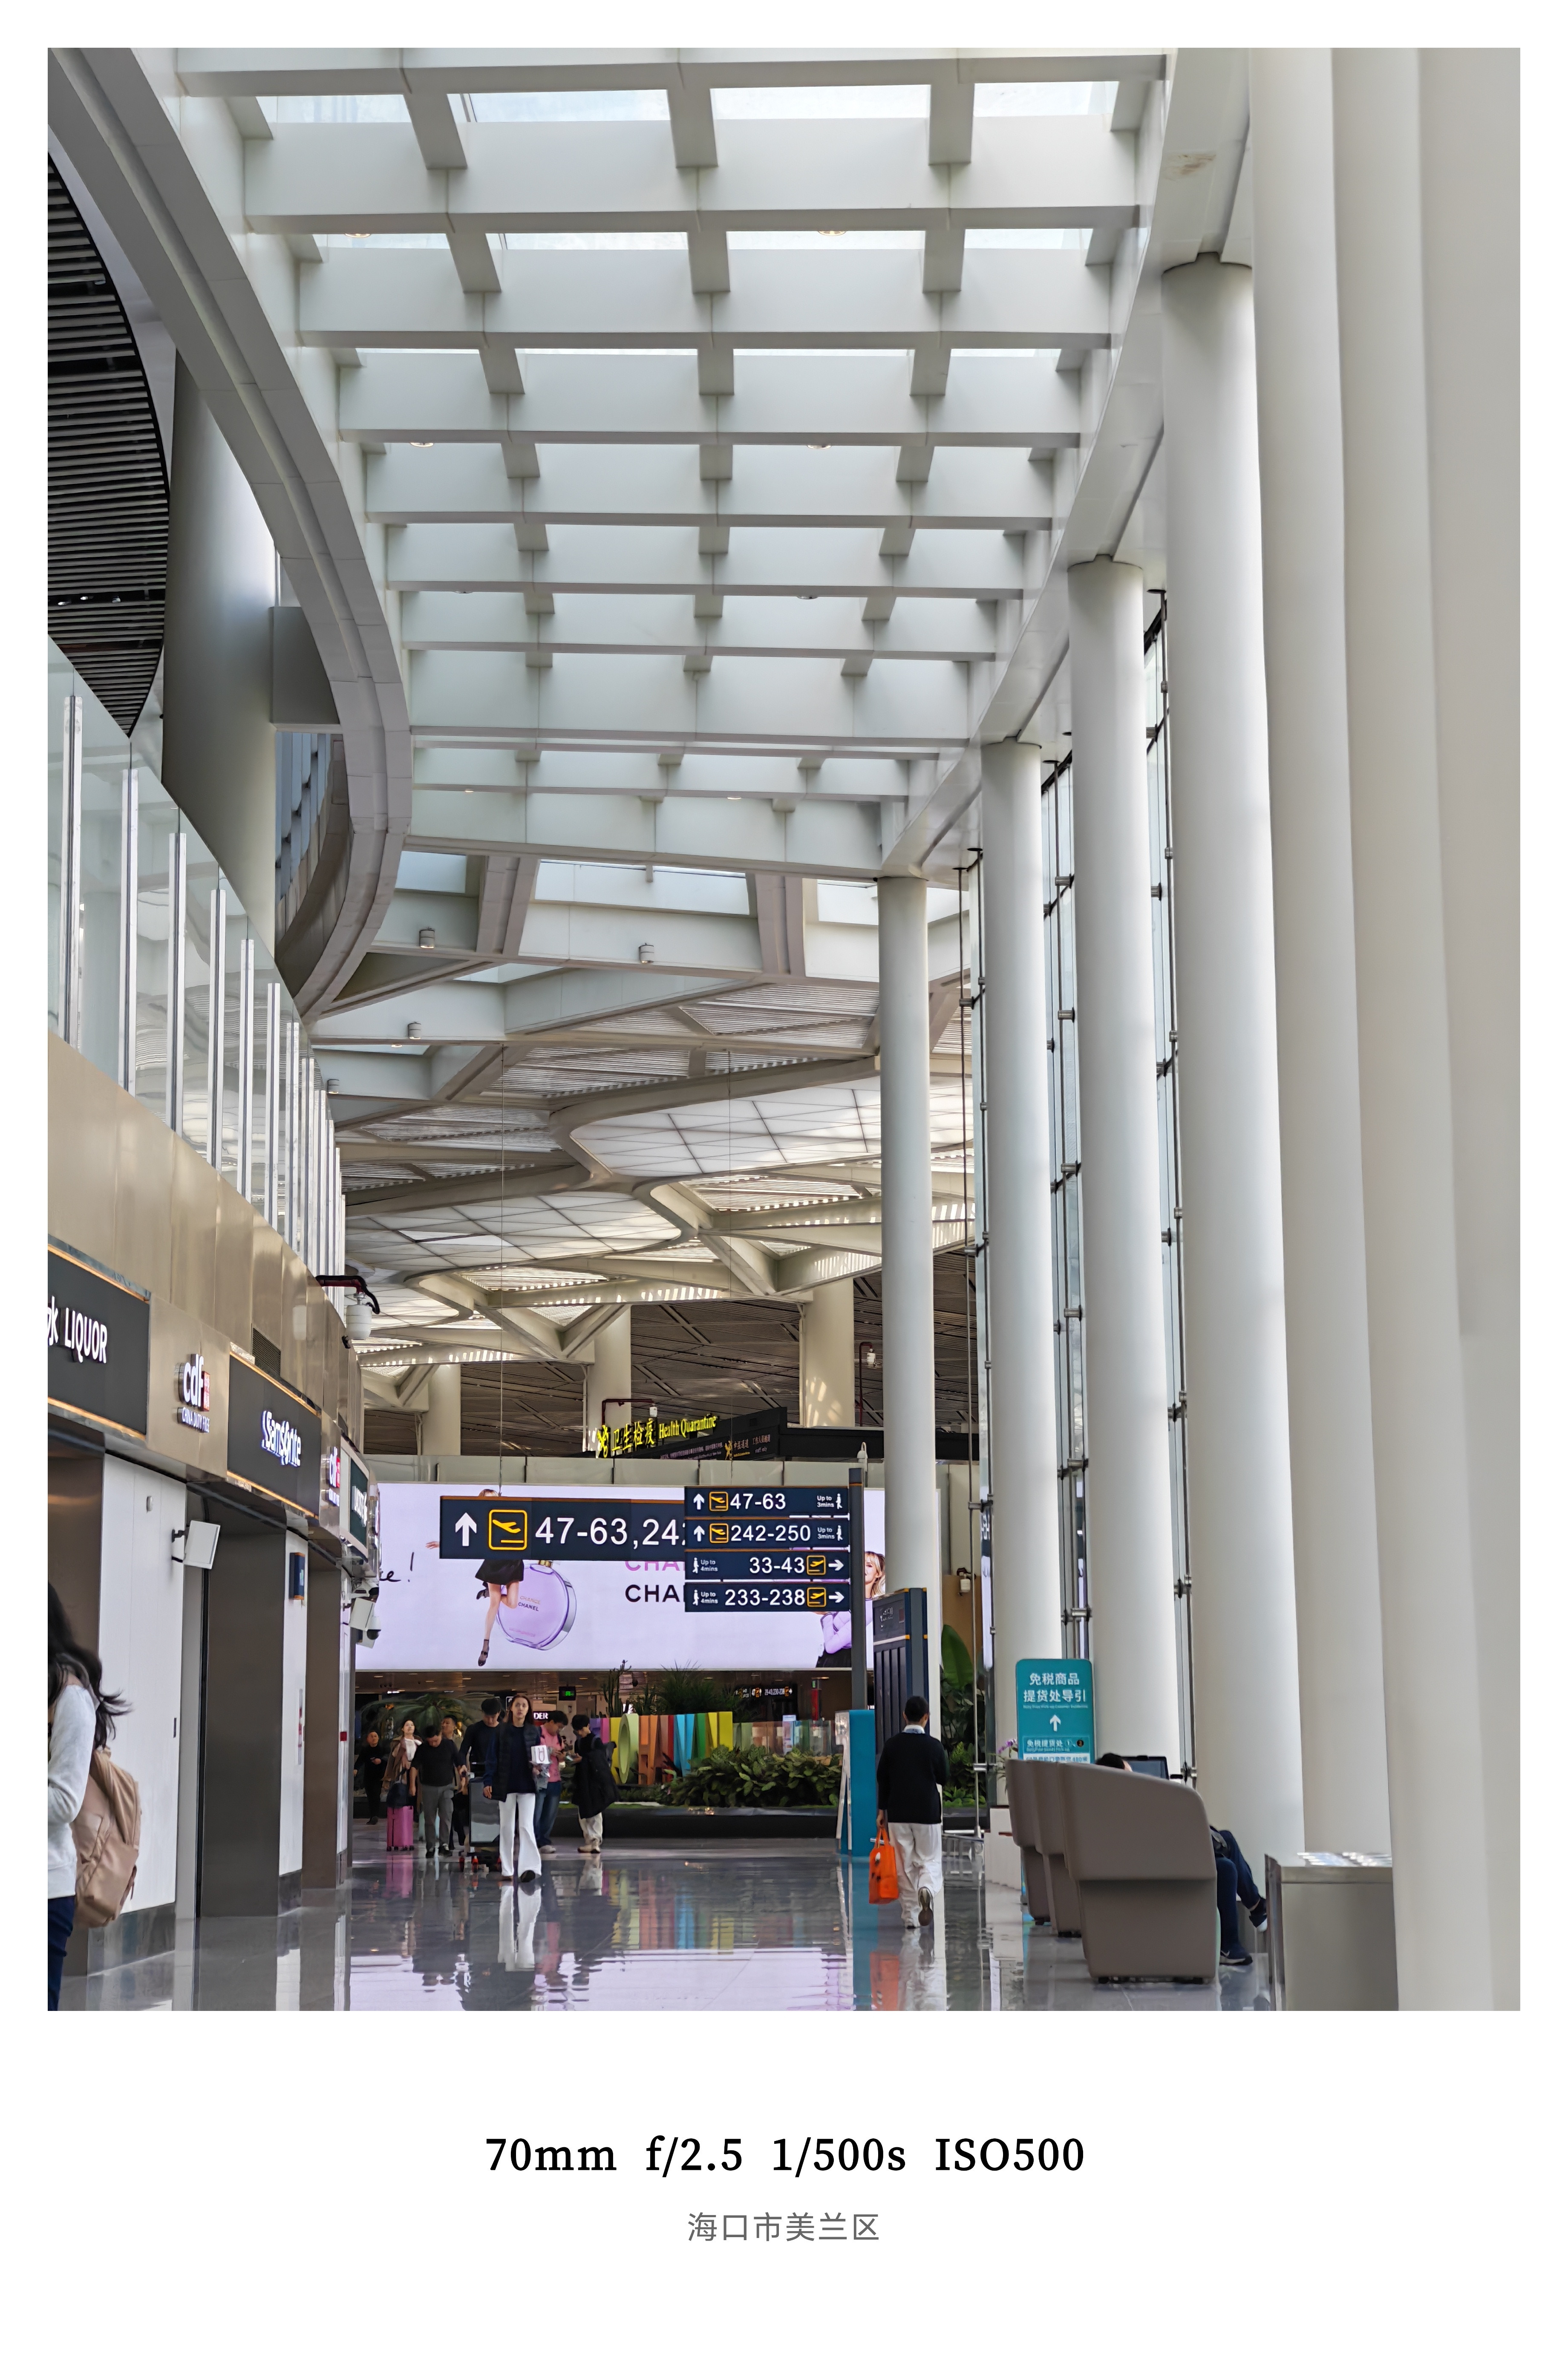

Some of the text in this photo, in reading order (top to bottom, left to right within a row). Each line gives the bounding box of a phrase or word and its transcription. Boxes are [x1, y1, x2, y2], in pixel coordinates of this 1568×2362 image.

[65, 1307, 107, 1363] LIQUOR
[184, 1354, 204, 1408] cdf
[182, 1407, 193, 1425] CHINA
[193, 1411, 203, 1429] DUTY
[659, 1415, 717, 1439] Health Quarantine
[261, 1410, 301, 1467] Samsonite
[611, 1418, 655, 1452] 卫生检疫
[730, 1493, 786, 1509] 47-63
[535, 1517, 685, 1550] 47-63,24
[731, 1525, 810, 1541] 242-250
[749, 1557, 805, 1574] 33-43
[625, 1584, 685, 1602] CHA
[725, 1589, 805, 1606] 233-238
[518, 1602, 539, 1611] CHANEL
[1029, 1672, 1080, 1686] 免税商品
[1023, 1688, 1086, 1702] 提货处导引
